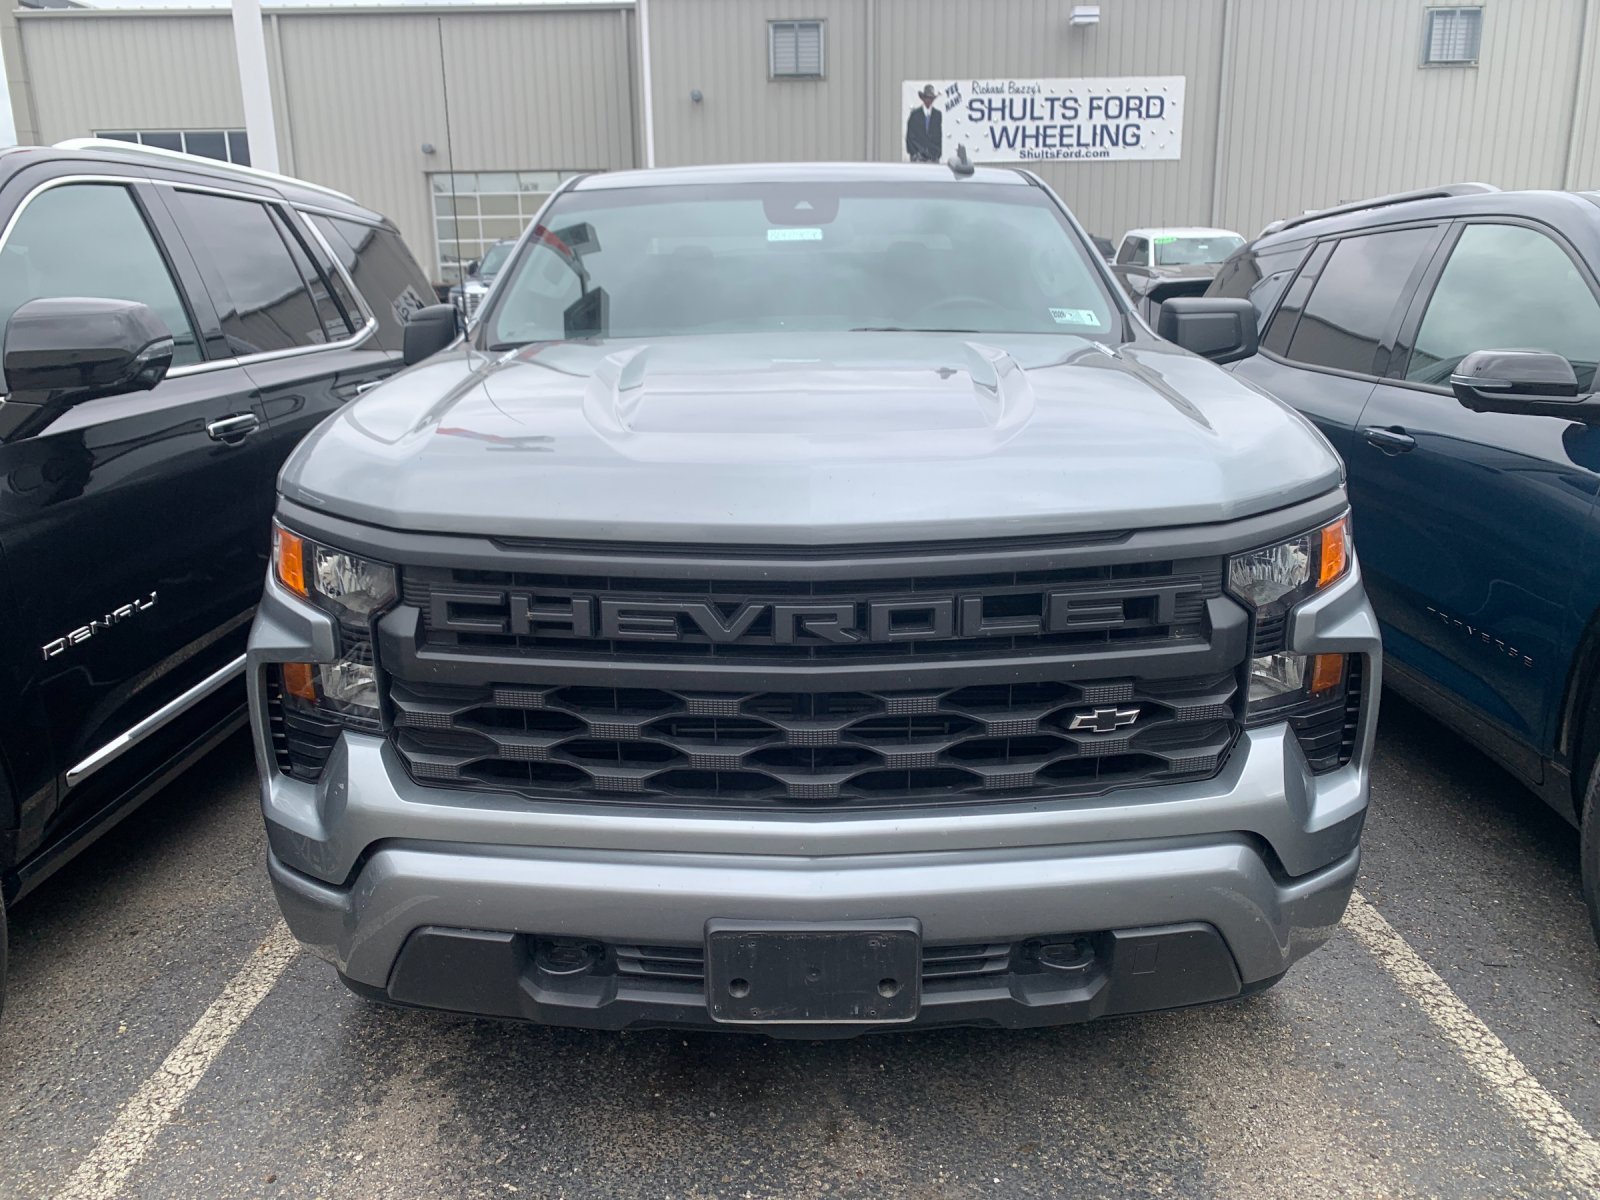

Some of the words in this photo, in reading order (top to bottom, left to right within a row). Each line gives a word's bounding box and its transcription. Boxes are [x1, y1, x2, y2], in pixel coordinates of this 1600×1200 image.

[971, 80, 1004, 94] Richard
[968, 97, 1079, 121] SHULTS
[1089, 95, 1165, 119] FORD
[989, 123, 1141, 148] WHEELING
[1019, 149, 1110, 159] ShultsFord.com
[41, 590, 158, 661] DENALI
[429, 583, 1204, 644] CHEVROLET
